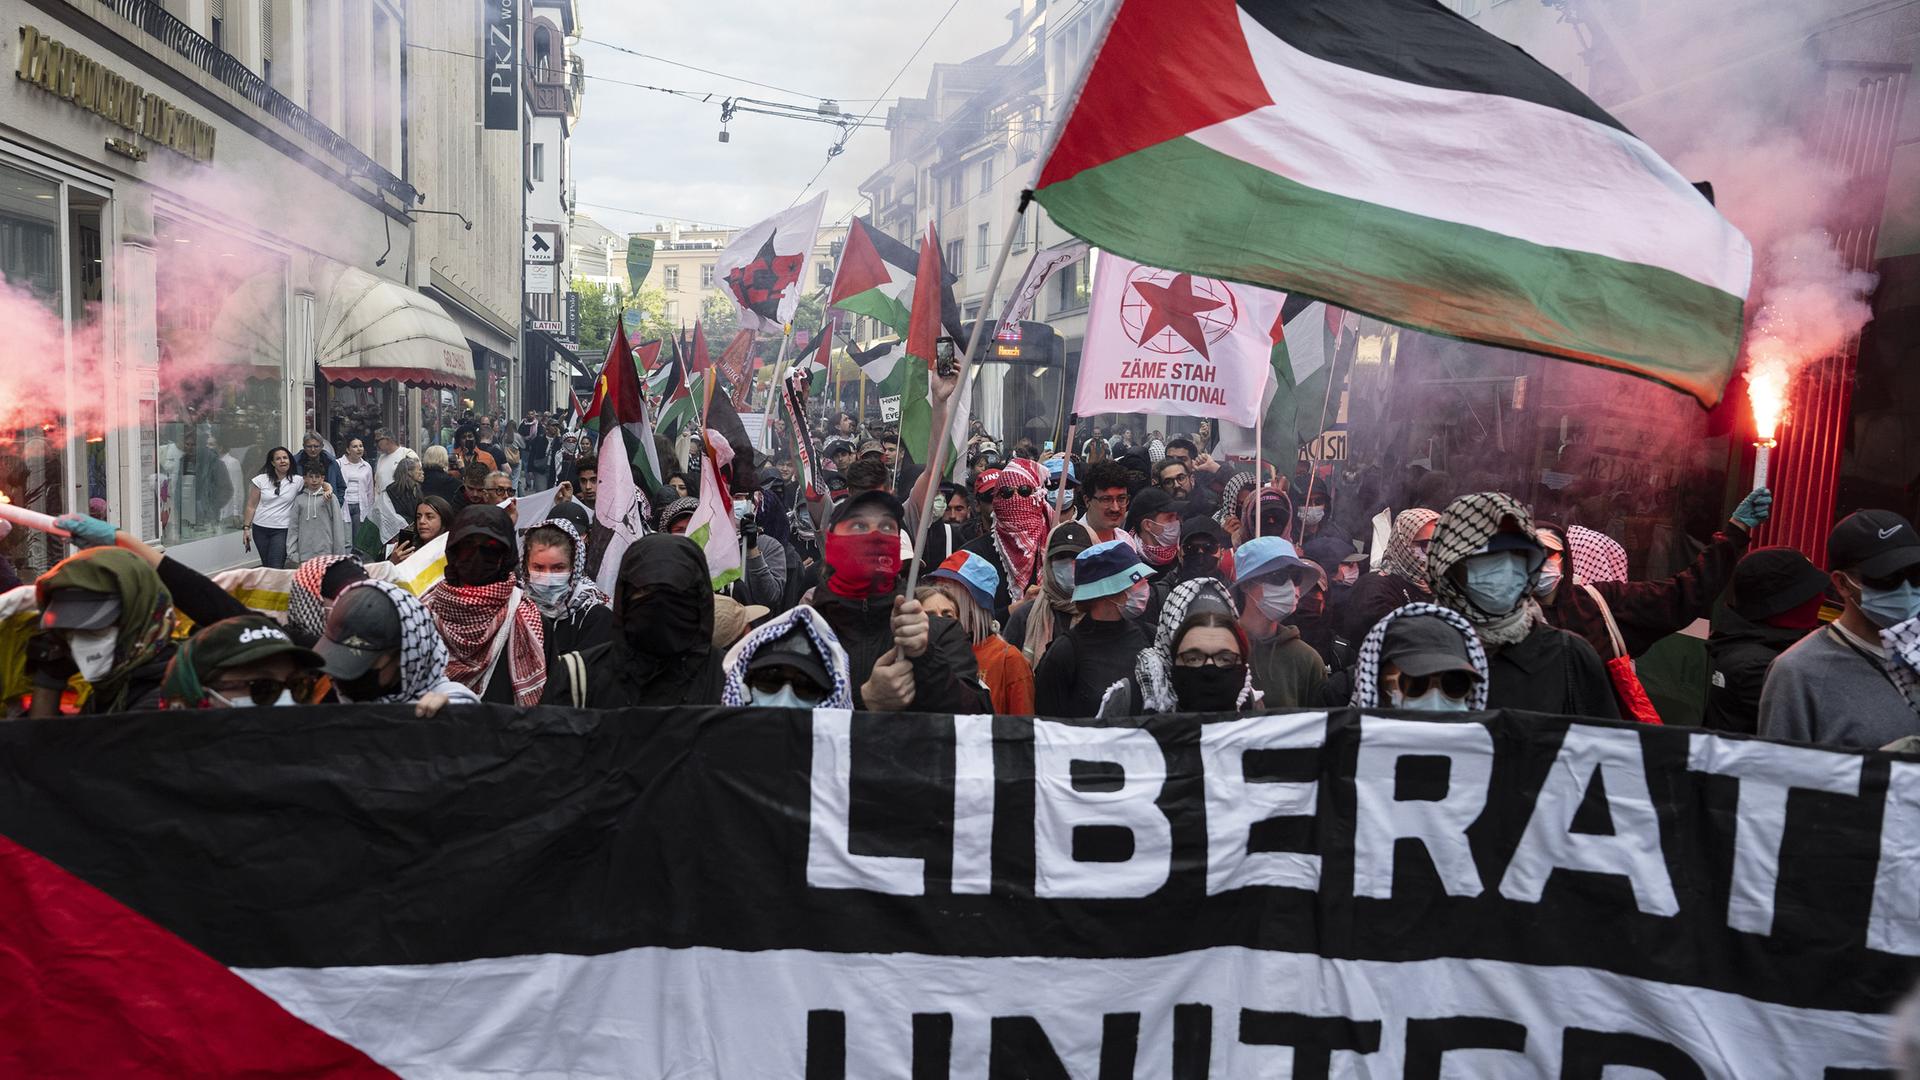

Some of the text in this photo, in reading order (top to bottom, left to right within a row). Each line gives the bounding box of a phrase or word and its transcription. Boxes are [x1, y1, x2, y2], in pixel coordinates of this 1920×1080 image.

[491, 24, 512, 96] PKZ
[533, 322, 560, 331] LATINI
[1120, 358, 1216, 383] ZÄME STAH
[1104, 382, 1227, 406] INTERNATIONAL
